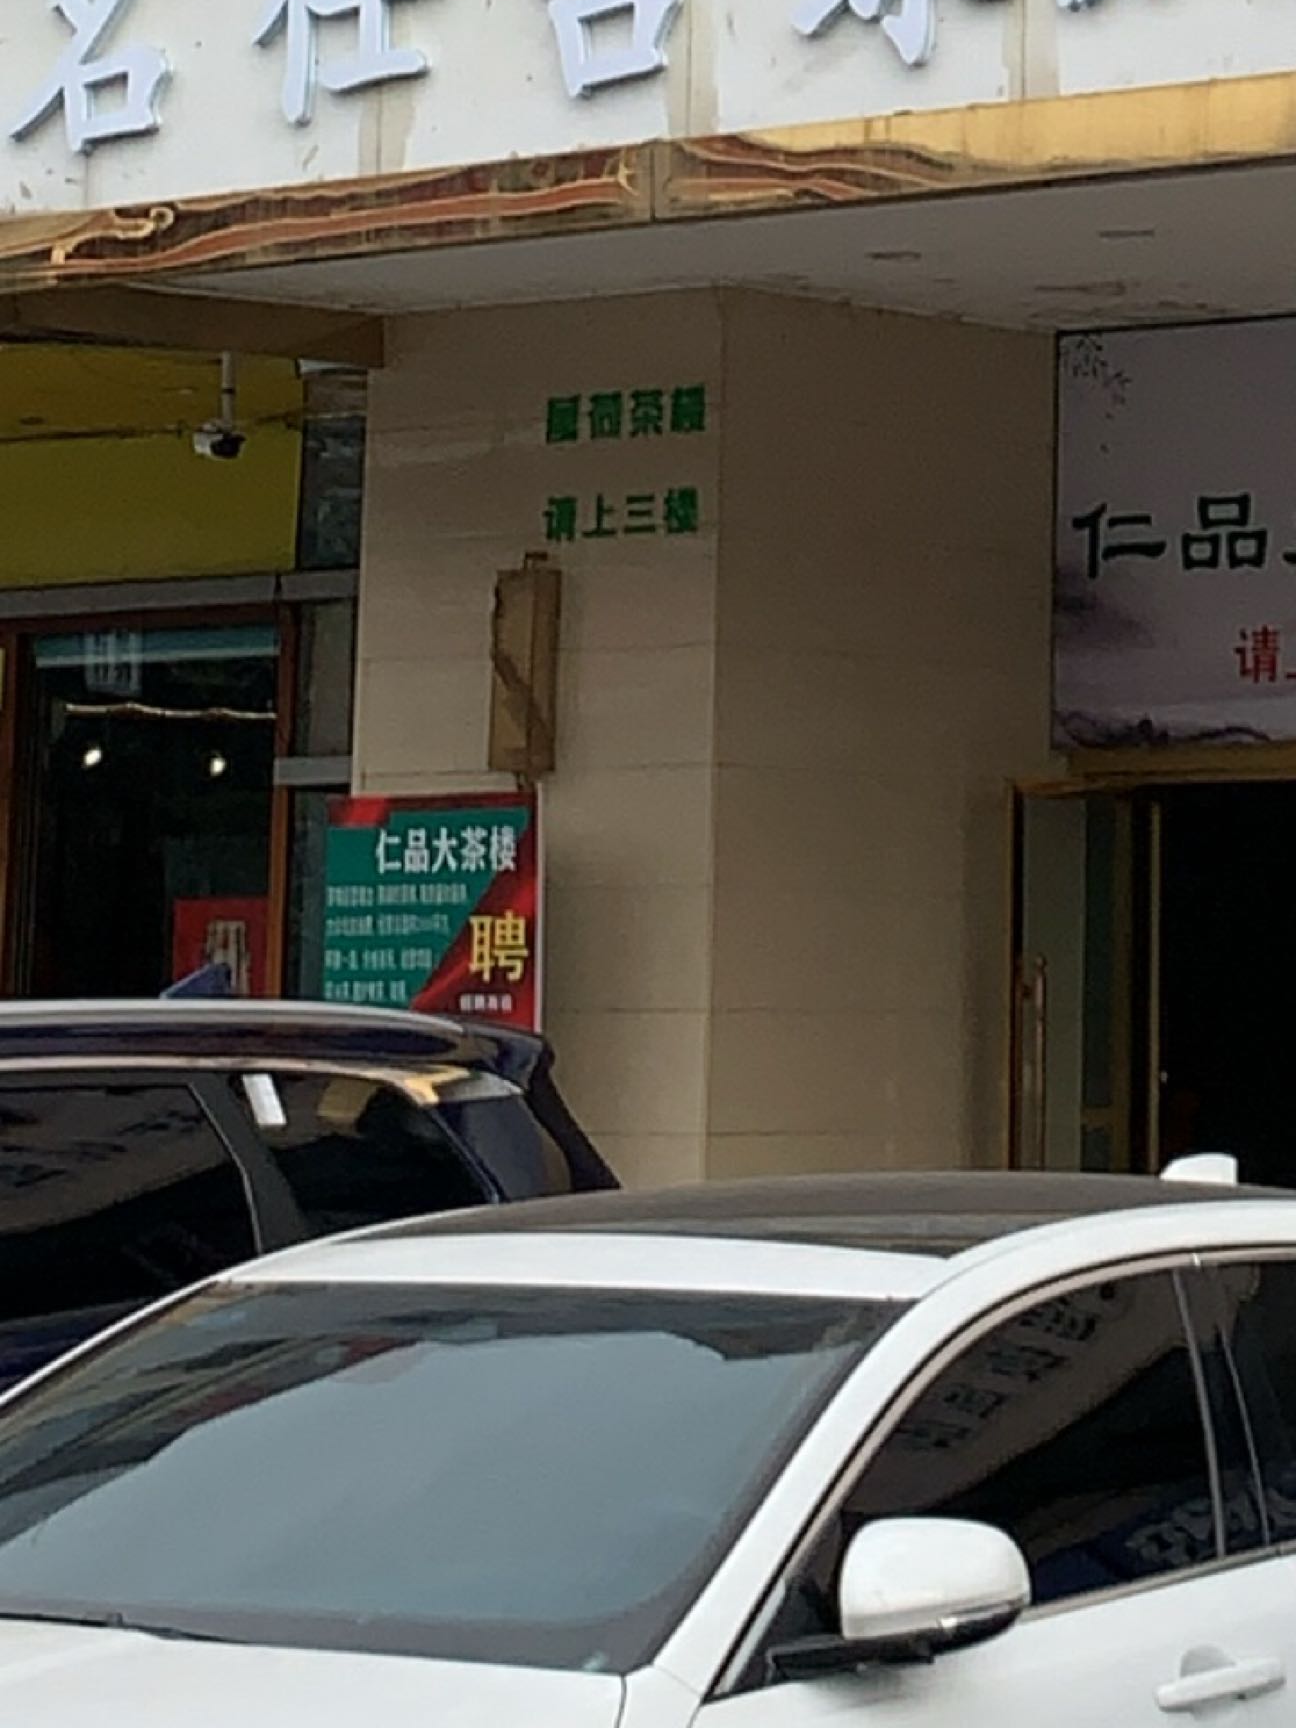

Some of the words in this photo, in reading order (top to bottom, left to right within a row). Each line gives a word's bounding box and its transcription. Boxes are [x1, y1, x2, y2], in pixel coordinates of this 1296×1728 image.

[542, 486, 698, 543] 请上三楼
[375, 825, 518, 874] 仁品大茶楼
[468, 910, 529, 982] 聘
